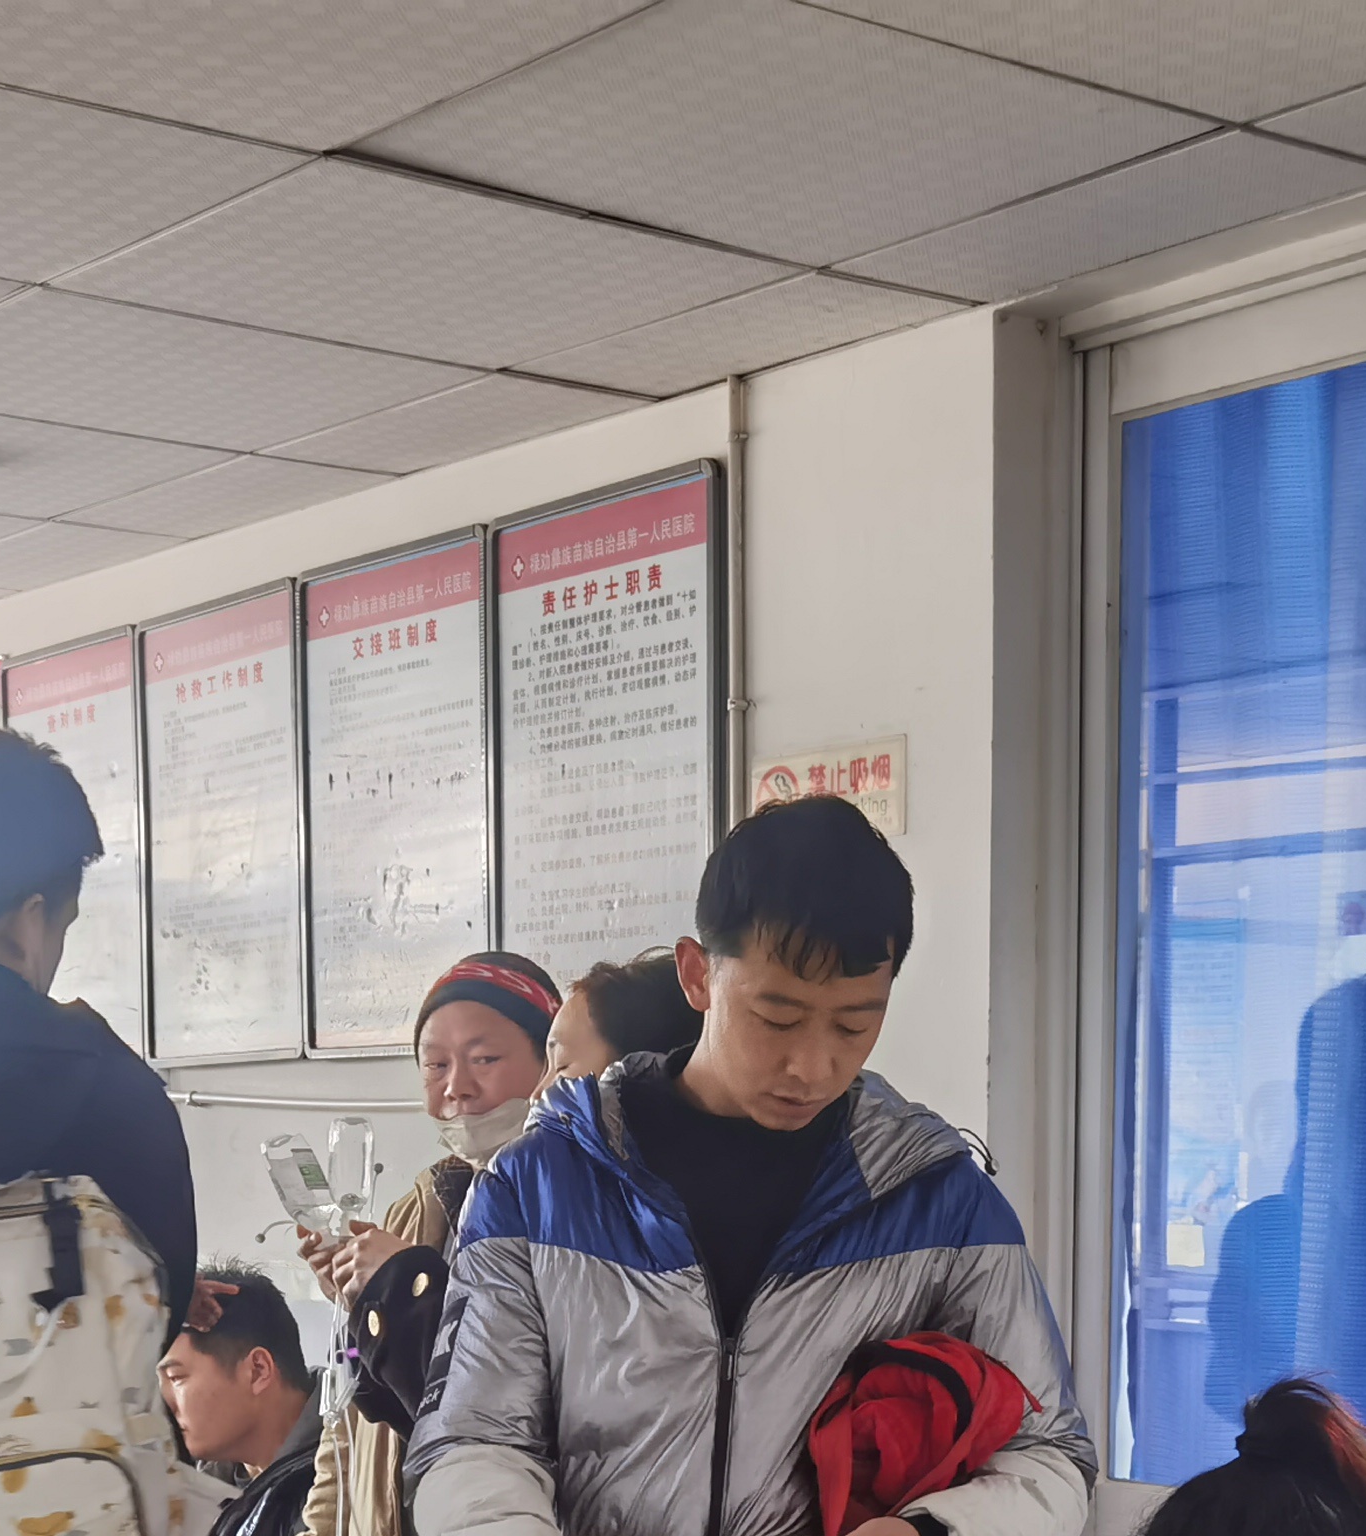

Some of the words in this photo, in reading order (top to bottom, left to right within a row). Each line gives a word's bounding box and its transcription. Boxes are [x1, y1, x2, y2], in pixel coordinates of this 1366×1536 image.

[541, 563, 663, 617] 责任护士职责
[351, 618, 438, 661] 交接班制度
[175, 660, 264, 705] 抢救工作制度
[808, 753, 891, 797] 禁止吸烟
